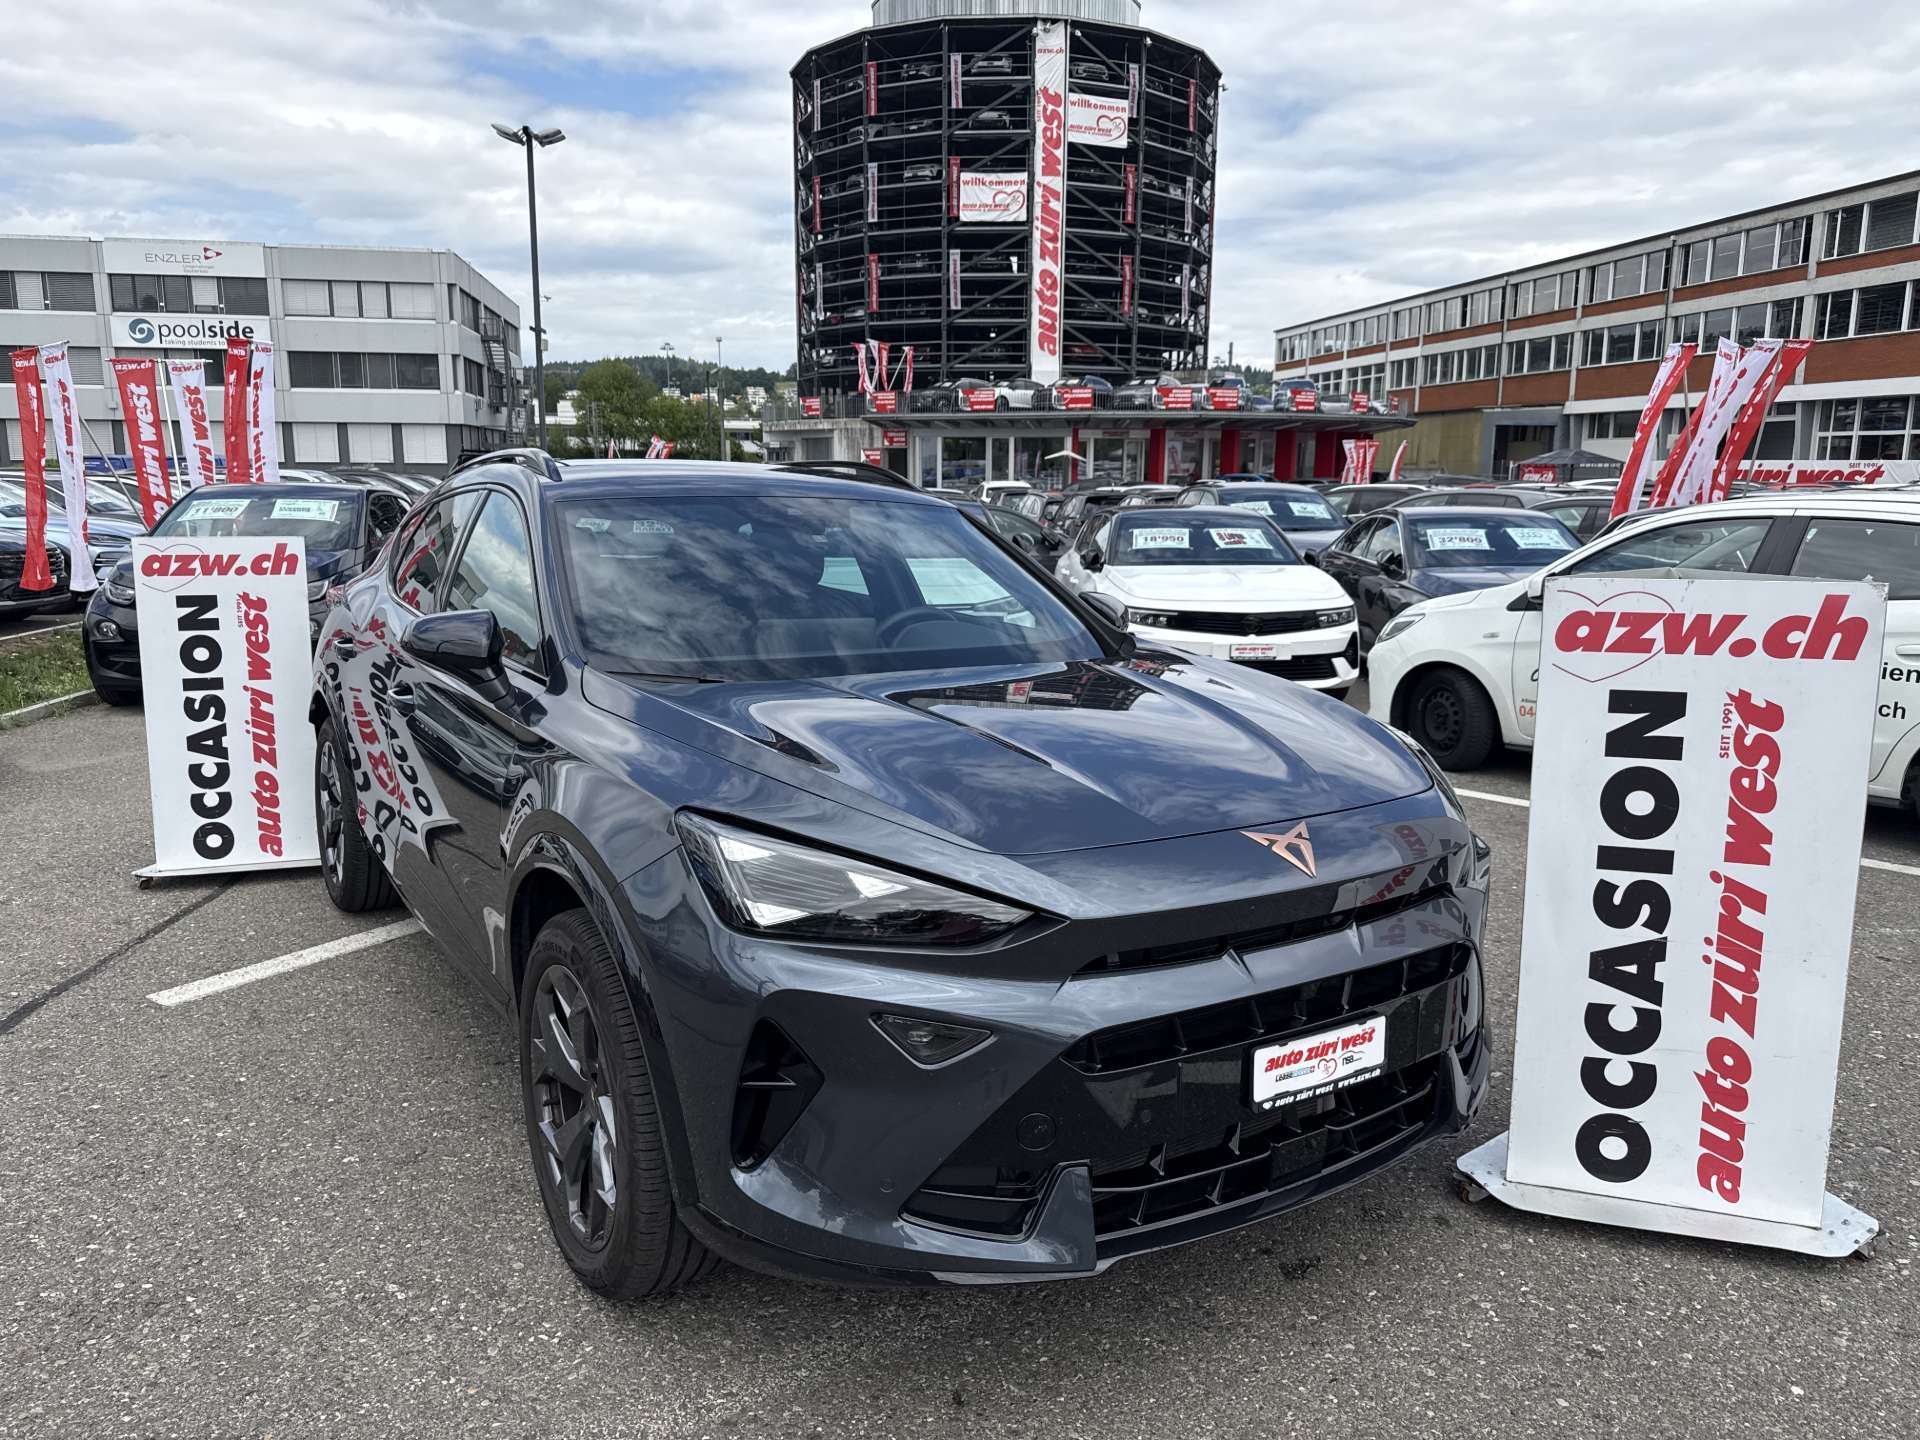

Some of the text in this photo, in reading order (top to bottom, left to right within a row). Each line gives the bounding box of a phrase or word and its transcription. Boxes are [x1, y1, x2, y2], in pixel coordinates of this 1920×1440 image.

[1069, 97, 1127, 113] willkommen
[962, 177, 1026, 187] willkommen
[1035, 86, 1063, 357] auto züri west
[144, 252, 202, 265] ENZLER
[158, 319, 255, 345] poolside
[164, 338, 187, 348] taking
[187, 338, 213, 348] students
[126, 381, 158, 442] west
[183, 384, 209, 441] west
[137, 444, 169, 500] züri
[141, 543, 299, 577] azw.ch
[1554, 595, 1869, 662] azw.ch
[175, 594, 235, 860] OCCASION
[236, 591, 283, 858] auto züri west
[1719, 702, 1734, 759] SEIT 1991
[1575, 688, 1688, 1184] OCCASION
[1692, 688, 1785, 1205] auto züri west
[1264, 1026, 1376, 1072] auto züri west
[1274, 1095, 1294, 1107] auto
[1295, 1088, 1314, 1102] züri
[1315, 1083, 1334, 1095] west
